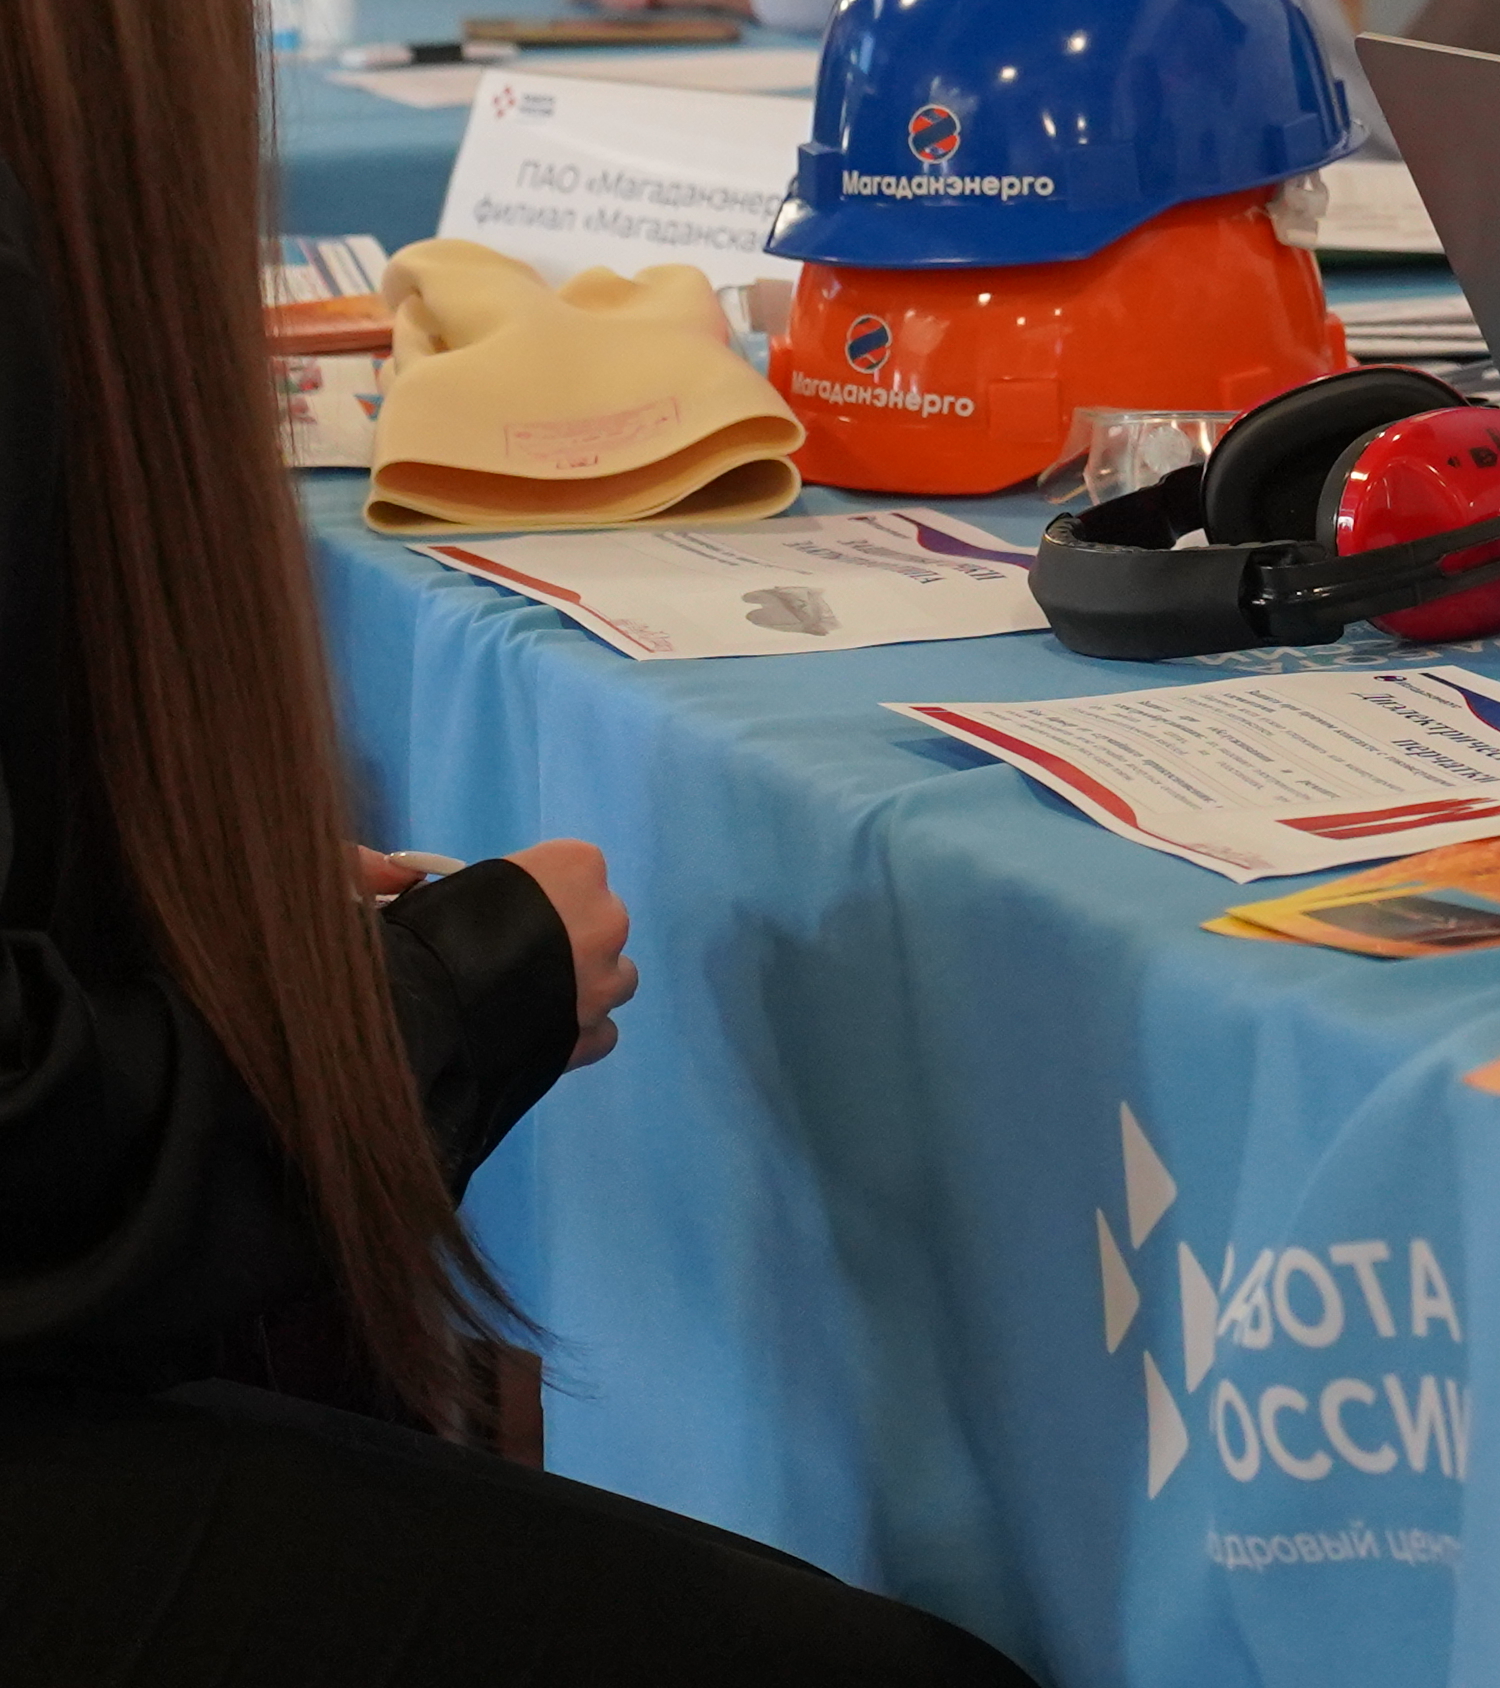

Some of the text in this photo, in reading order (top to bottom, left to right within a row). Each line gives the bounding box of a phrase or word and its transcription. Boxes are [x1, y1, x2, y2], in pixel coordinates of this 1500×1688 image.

[517, 160, 784, 220] ПАО «Магаданэнер
[842, 170, 1054, 201] Магаданэнерго
[474, 196, 762, 253] филиал «Магаданска
[792, 370, 975, 417] Магаданэнерго
